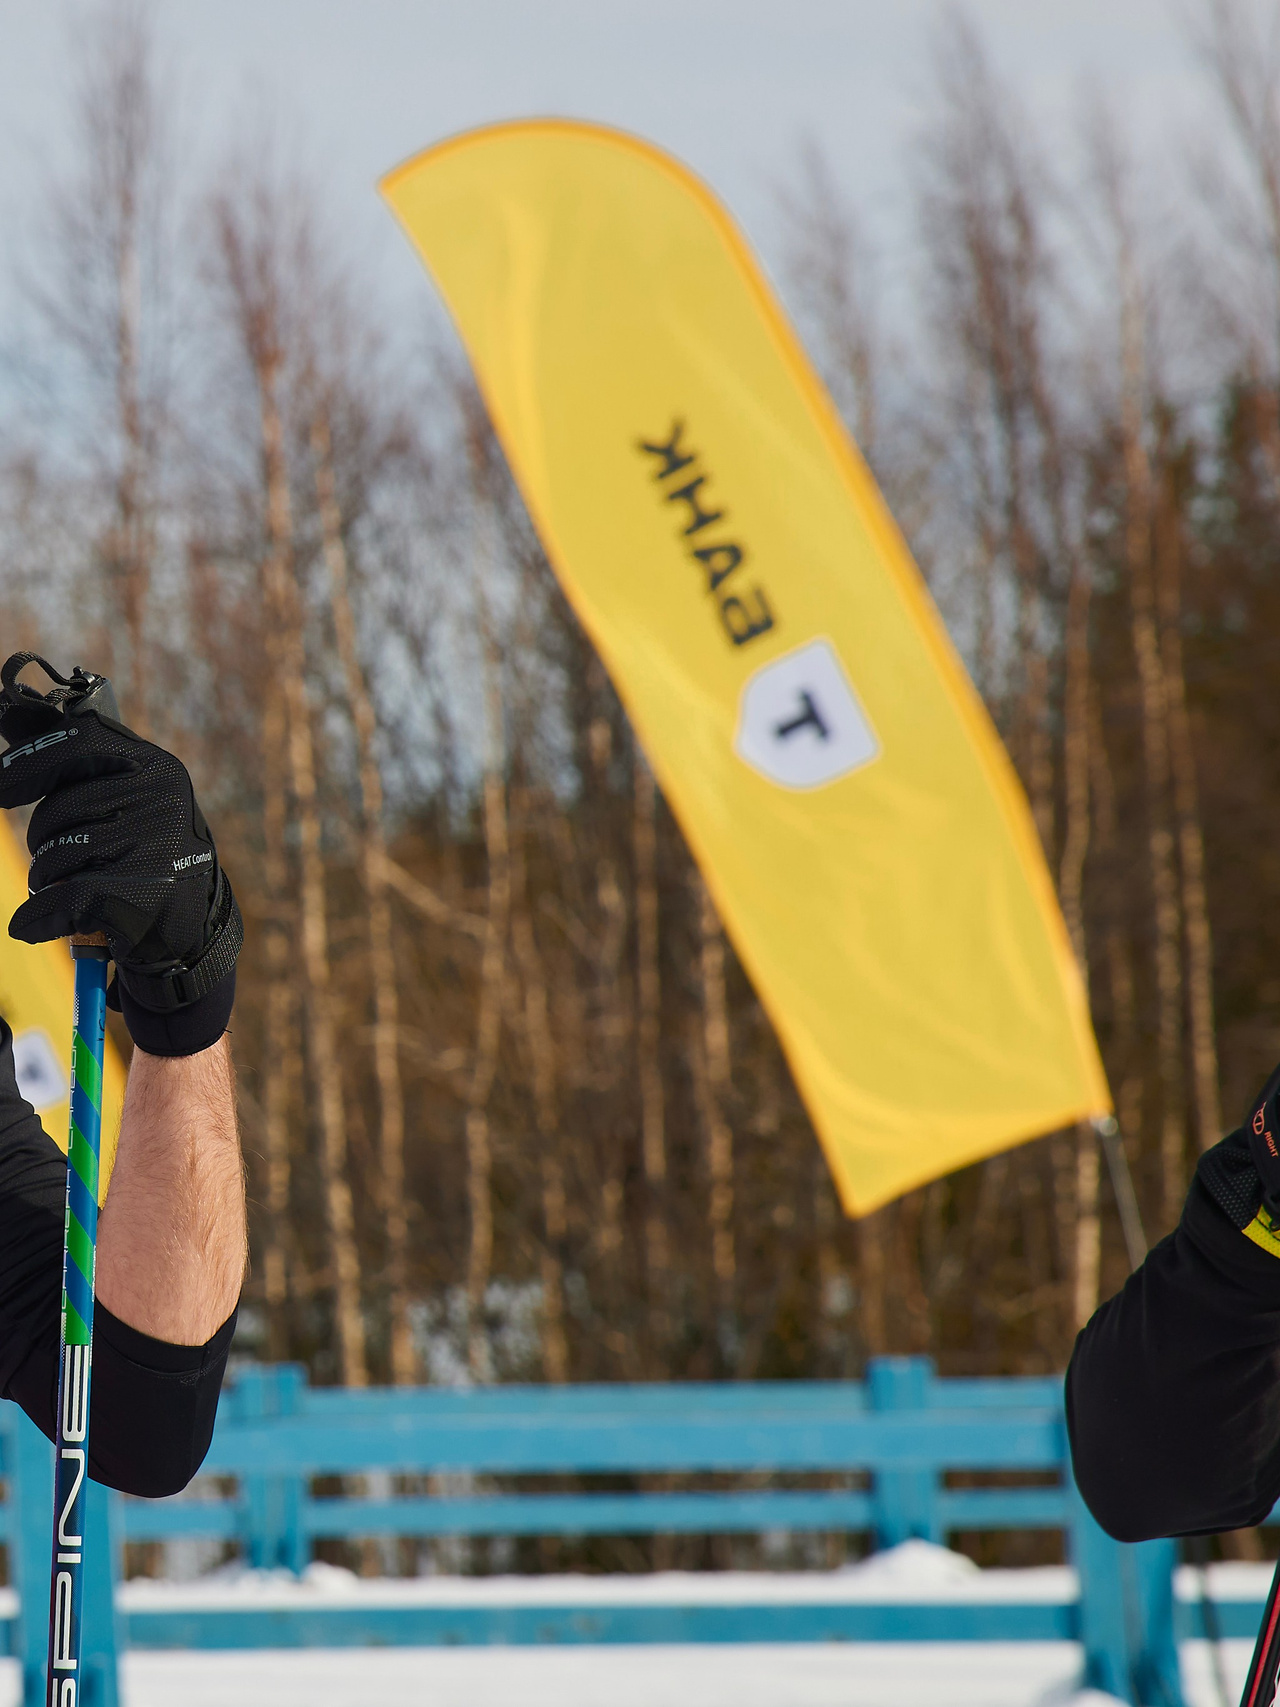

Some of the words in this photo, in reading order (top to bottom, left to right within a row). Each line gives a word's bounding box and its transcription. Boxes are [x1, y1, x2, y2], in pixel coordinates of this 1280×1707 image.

[59, 834, 90, 846] RACE
[173, 855, 192, 871] HEAT
[1264, 1130, 1279, 1157] RIGHT
